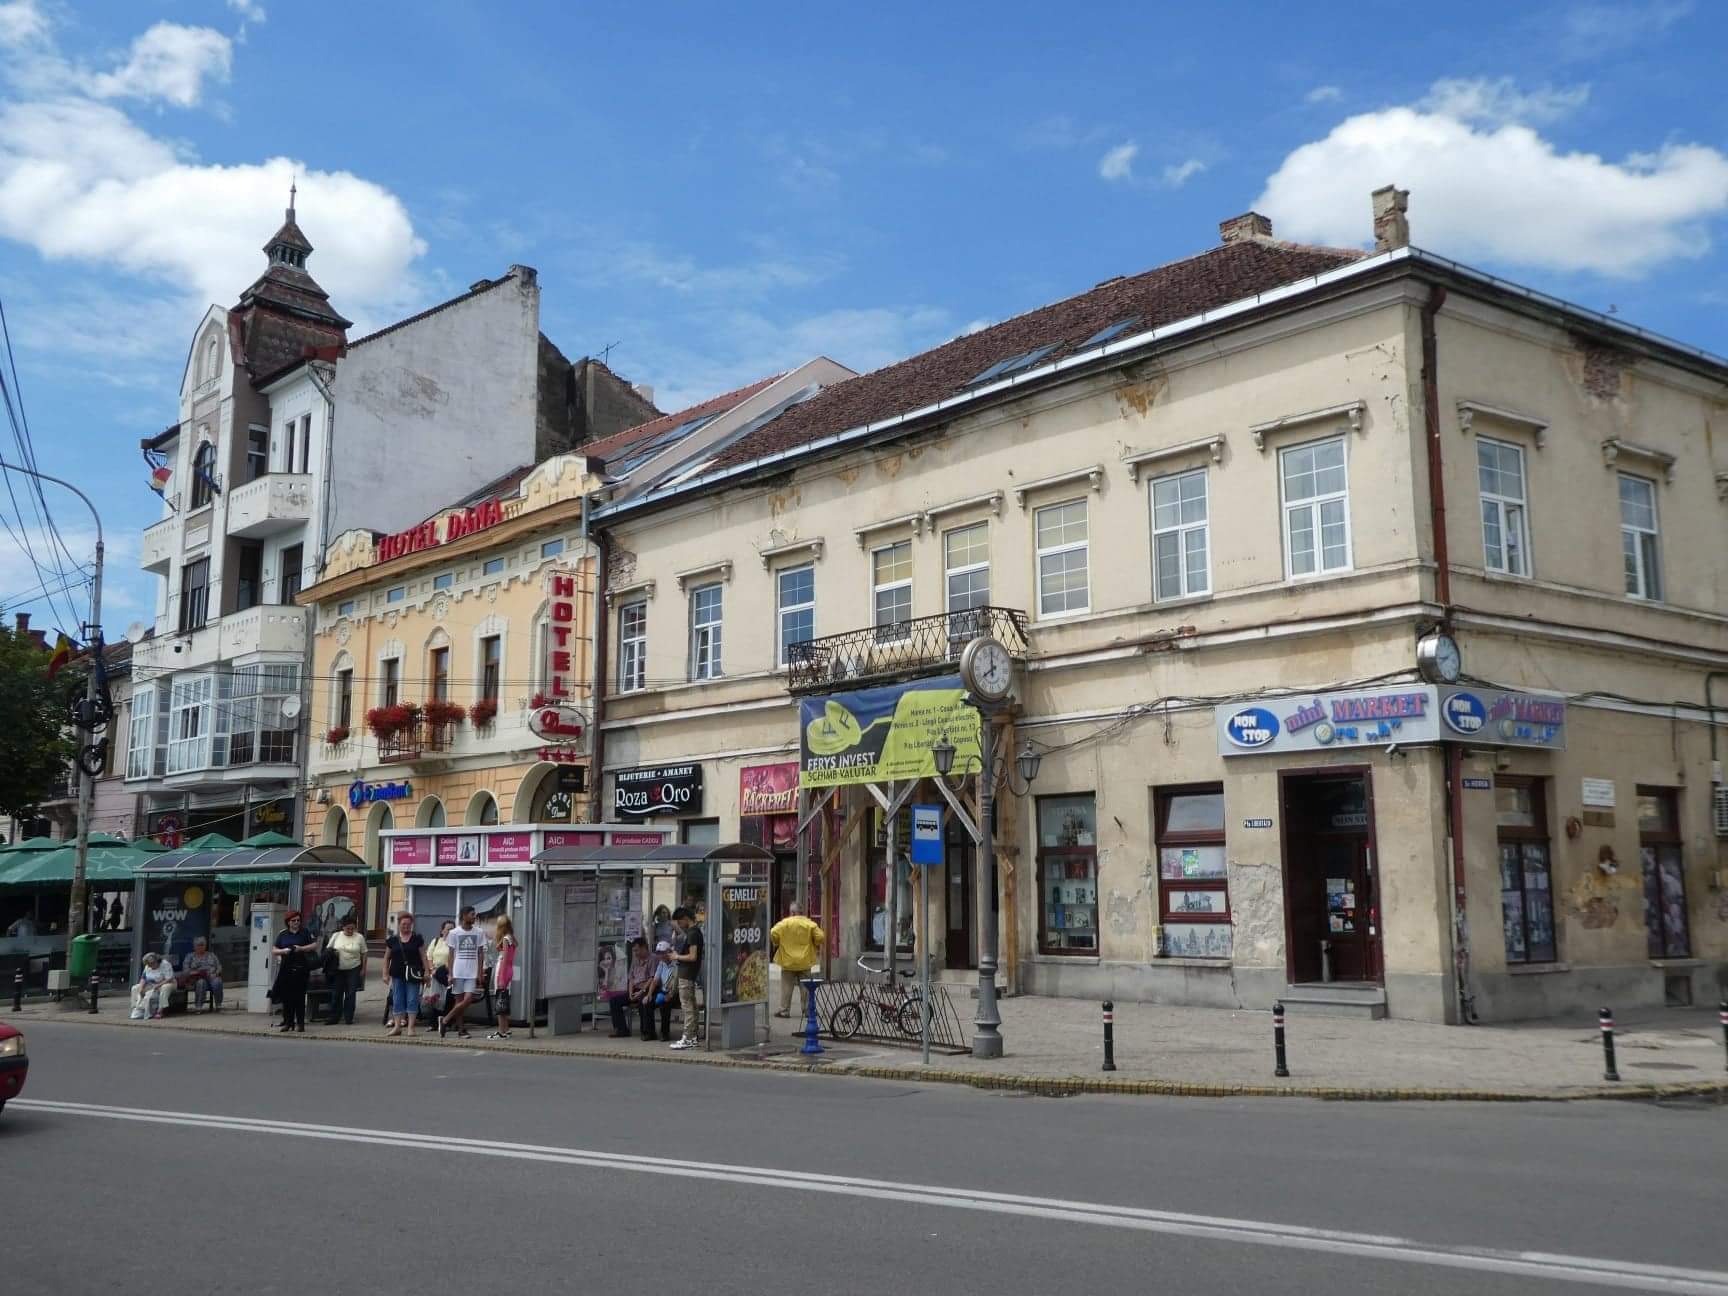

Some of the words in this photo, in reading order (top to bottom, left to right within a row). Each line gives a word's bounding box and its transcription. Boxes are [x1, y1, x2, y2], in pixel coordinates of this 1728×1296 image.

[378, 520, 440, 562] HOTEL
[447, 496, 504, 541] DANA
[552, 575, 576, 696] HOTEL
[1284, 699, 1327, 733] mini
[1331, 692, 1428, 723] MARKET
[1451, 699, 1472, 713] NON
[1233, 715, 1257, 729] NON
[1458, 715, 1482, 729] STOP
[1241, 729, 1271, 742] STOP
[807, 755, 837, 771] FERYS
[839, 751, 876, 768] INVEST
[618, 770, 656, 782] BIJUTERIE
[662, 766, 694, 777] AMANET
[807, 768, 838, 782] SCHIMB
[839, 765, 877, 779] VALUTAR
[546, 792, 571, 810] HOTEL
[615, 788, 648, 807] Roza
[661, 783, 690, 803] Oro
[548, 836, 564, 845] AICI
[152, 910, 188, 921] WOW
[733, 927, 761, 945] 8989
